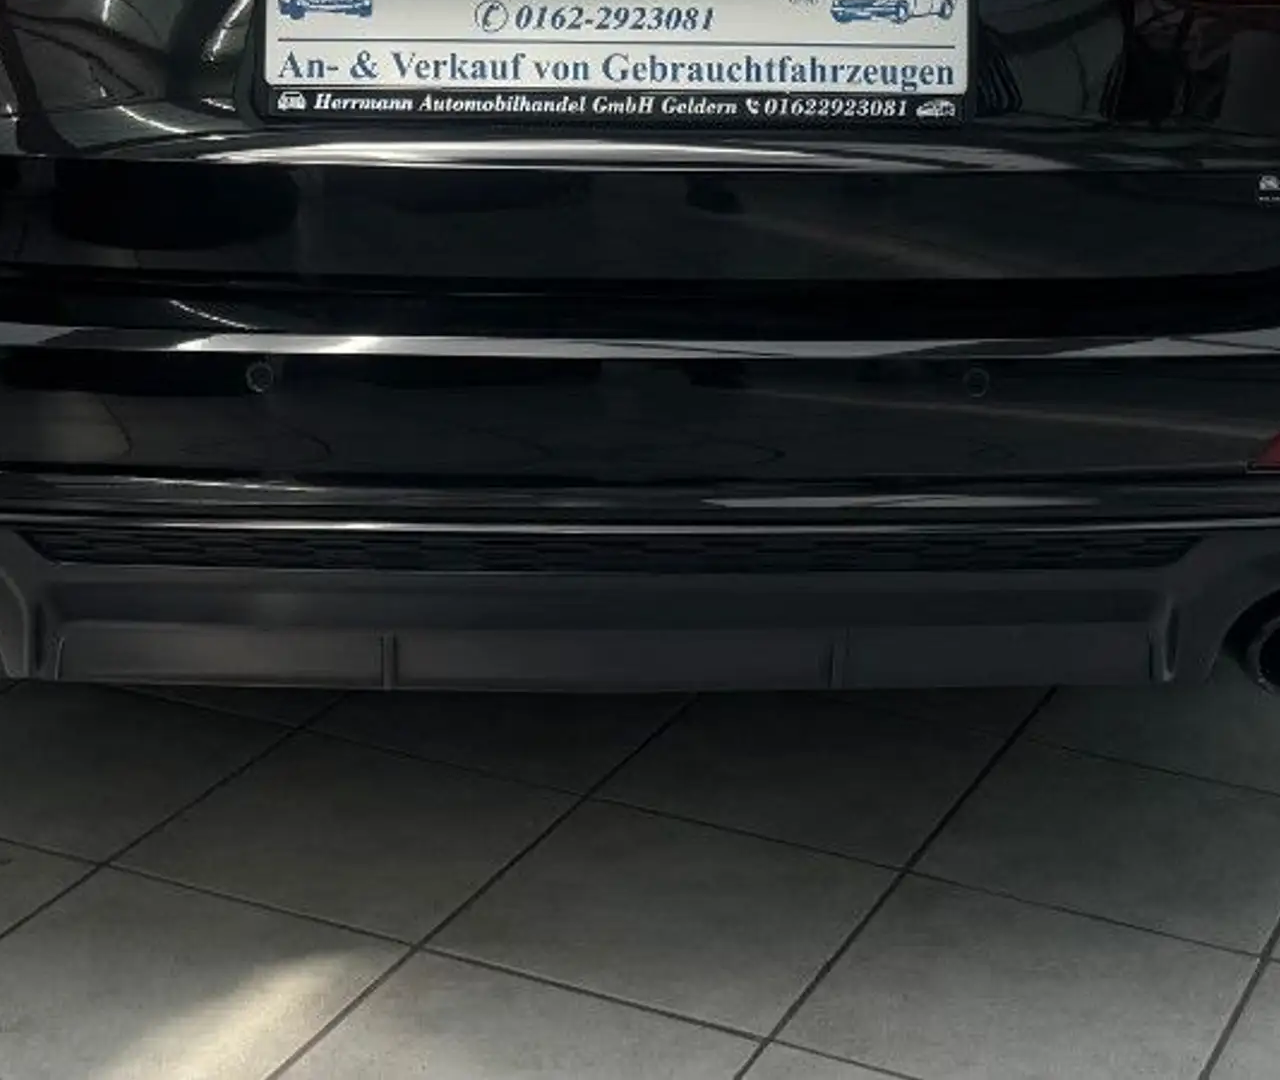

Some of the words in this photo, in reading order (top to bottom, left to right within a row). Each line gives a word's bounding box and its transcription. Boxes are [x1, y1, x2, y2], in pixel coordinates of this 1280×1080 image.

[515, 5, 715, 32] 0162-2923081
[278, 51, 339, 79] An-
[349, 50, 378, 80] &
[391, 52, 526, 81] Verkauf
[533, 59, 590, 82] von
[601, 53, 956, 92] Gebrauchtfahrzeugen
[313, 92, 414, 112] Herrmann
[419, 94, 586, 114] Automobilhandel
[591, 96, 655, 115] GmbH
[661, 97, 738, 116] Geldern
[764, 98, 909, 118] 01622923081
